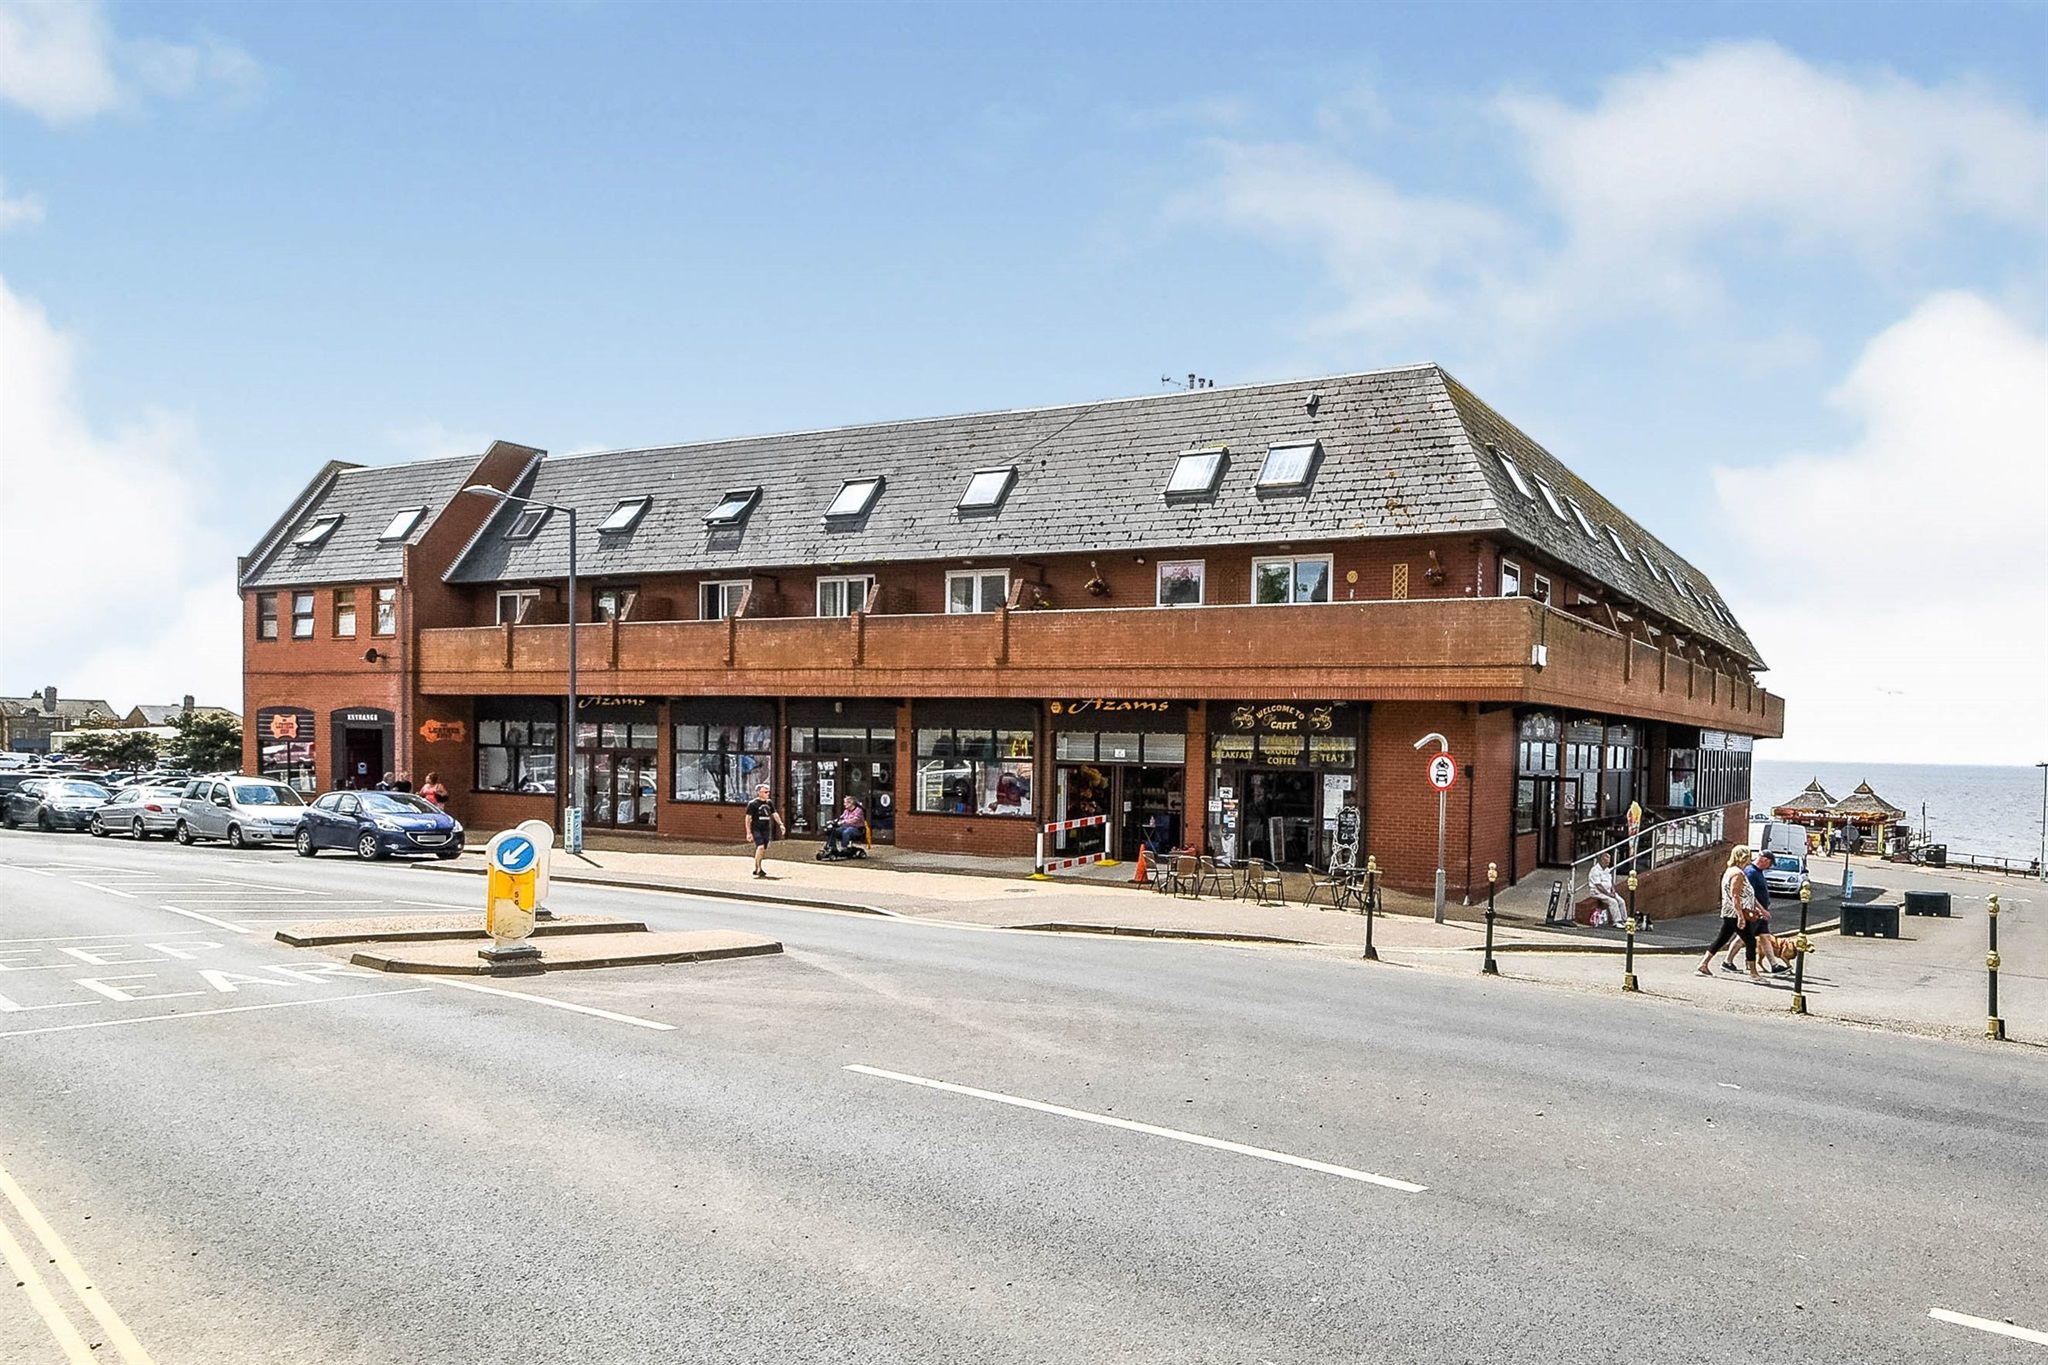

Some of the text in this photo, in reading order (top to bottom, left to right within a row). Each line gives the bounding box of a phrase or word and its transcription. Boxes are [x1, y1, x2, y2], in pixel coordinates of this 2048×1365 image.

[1067, 698, 1169, 715] Azams
[1255, 704, 1295, 719] WELCOME
[1295, 709, 1305, 720] TO
[1211, 750, 1253, 760] BREAKFAST
[1264, 746, 1300, 756] GROUND
[1267, 757, 1297, 765] COFFEE
[1320, 753, 1345, 763] TEA'S
